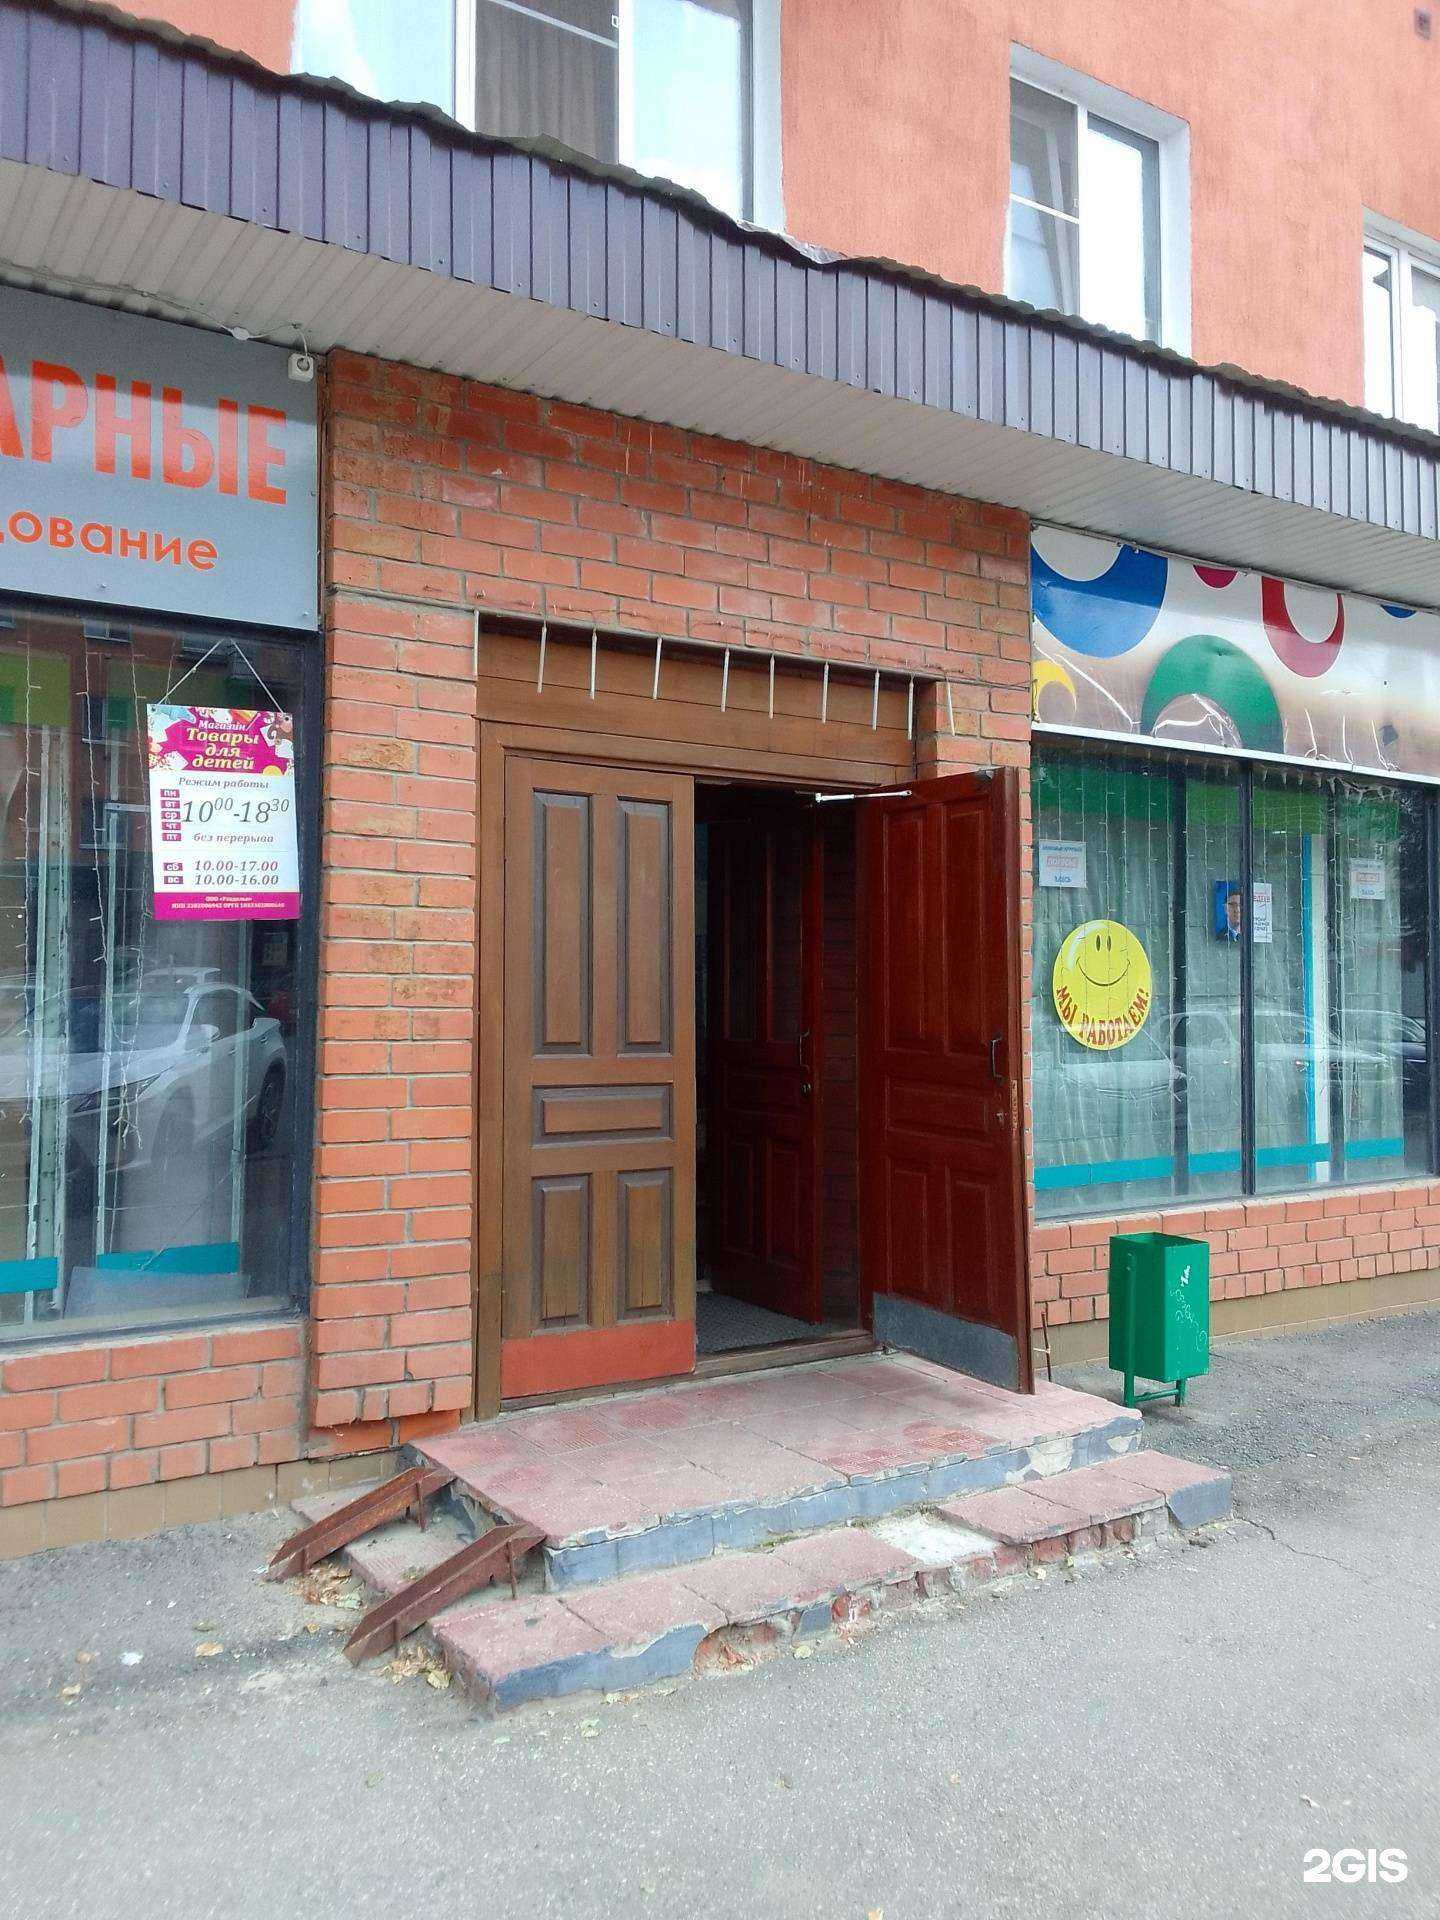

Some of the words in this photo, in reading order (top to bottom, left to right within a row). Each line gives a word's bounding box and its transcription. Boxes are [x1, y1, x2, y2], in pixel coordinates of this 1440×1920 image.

[0, 510, 219, 571] ование
[199, 720, 246, 731] Магазин
[187, 727, 259, 746] Товары
[205, 743, 241, 758] для
[192, 754, 255, 770] детей
[179, 777, 221, 788] Режим
[223, 779, 269, 789] работы
[193, 832, 213, 843] без
[216, 835, 274, 845] перерыва
[194, 860, 278, 872] 10.00-17.00
[195, 875, 279, 886] 10.00-16.00
[1056, 986, 1077, 1027] МЫ
[1079, 988, 1149, 1046] РАБОТАЕМ!
